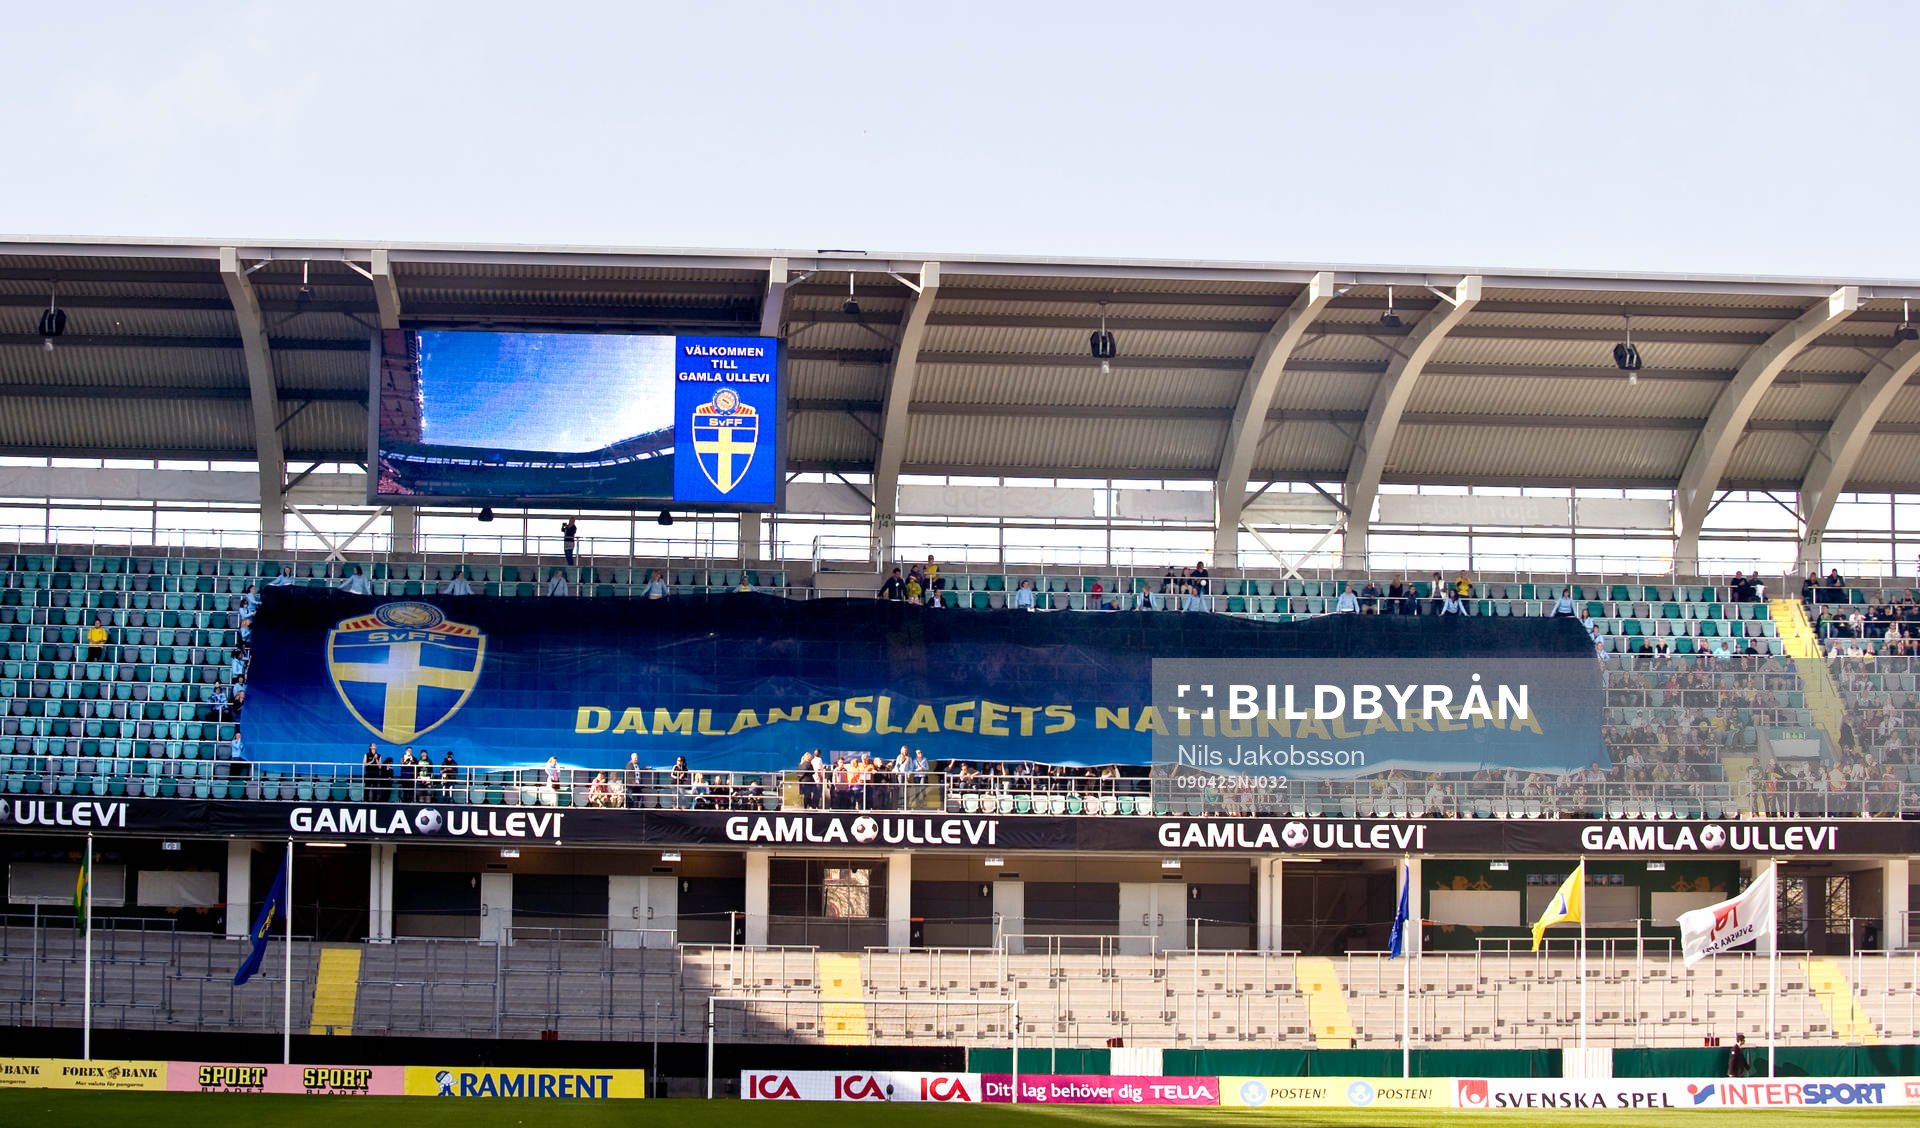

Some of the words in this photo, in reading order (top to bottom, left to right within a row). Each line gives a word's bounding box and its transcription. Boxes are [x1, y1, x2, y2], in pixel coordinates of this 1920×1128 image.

[685, 344, 764, 357] VÄLKOMMEN
[711, 359, 738, 369] TILL
[679, 372, 723, 382] GAMLA
[726, 373, 770, 383] ULLEVI
[708, 418, 743, 427] SvFF
[367, 631, 448, 643] SvFF
[574, 695, 1077, 737] DAMLANDSLAGETS
[15, 803, 128, 827] ULLEVI
[289, 807, 413, 834] GAMLA
[447, 812, 562, 838] ULLEVI
[725, 815, 848, 843] GAMLA
[882, 819, 998, 845] ULLEVI
[1158, 822, 1281, 848] GAMLA
[1312, 824, 1426, 850] ULLEVI
[1581, 825, 1697, 851] GAMLA
[1730, 826, 1837, 851] ULLEVI
[4, 1065, 41, 1075] BANK
[62, 1066, 105, 1077] FOREX
[122, 1068, 158, 1078] BANK
[199, 1065, 268, 1088] SPORT
[303, 1068, 373, 1090] SPORT
[459, 1072, 614, 1099] RAMIRENT
[749, 1074, 802, 1099] ICA
[834, 1075, 886, 1100] ICA
[920, 1077, 972, 1101] ICA
[1022, 1083, 1047, 1101] lag
[1051, 1083, 1115, 1099] behöver
[1118, 1086, 1143, 1103] dig
[1150, 1085, 1215, 1100] TELIA
[1270, 1088, 1327, 1099] POSTEN!
[1377, 1088, 1433, 1100] POSTEN!
[1720, 1083, 1886, 1105] INTERSPORT
[1495, 1092, 1607, 1108] SVENSKA
[1617, 1092, 1675, 1108] SPEL
